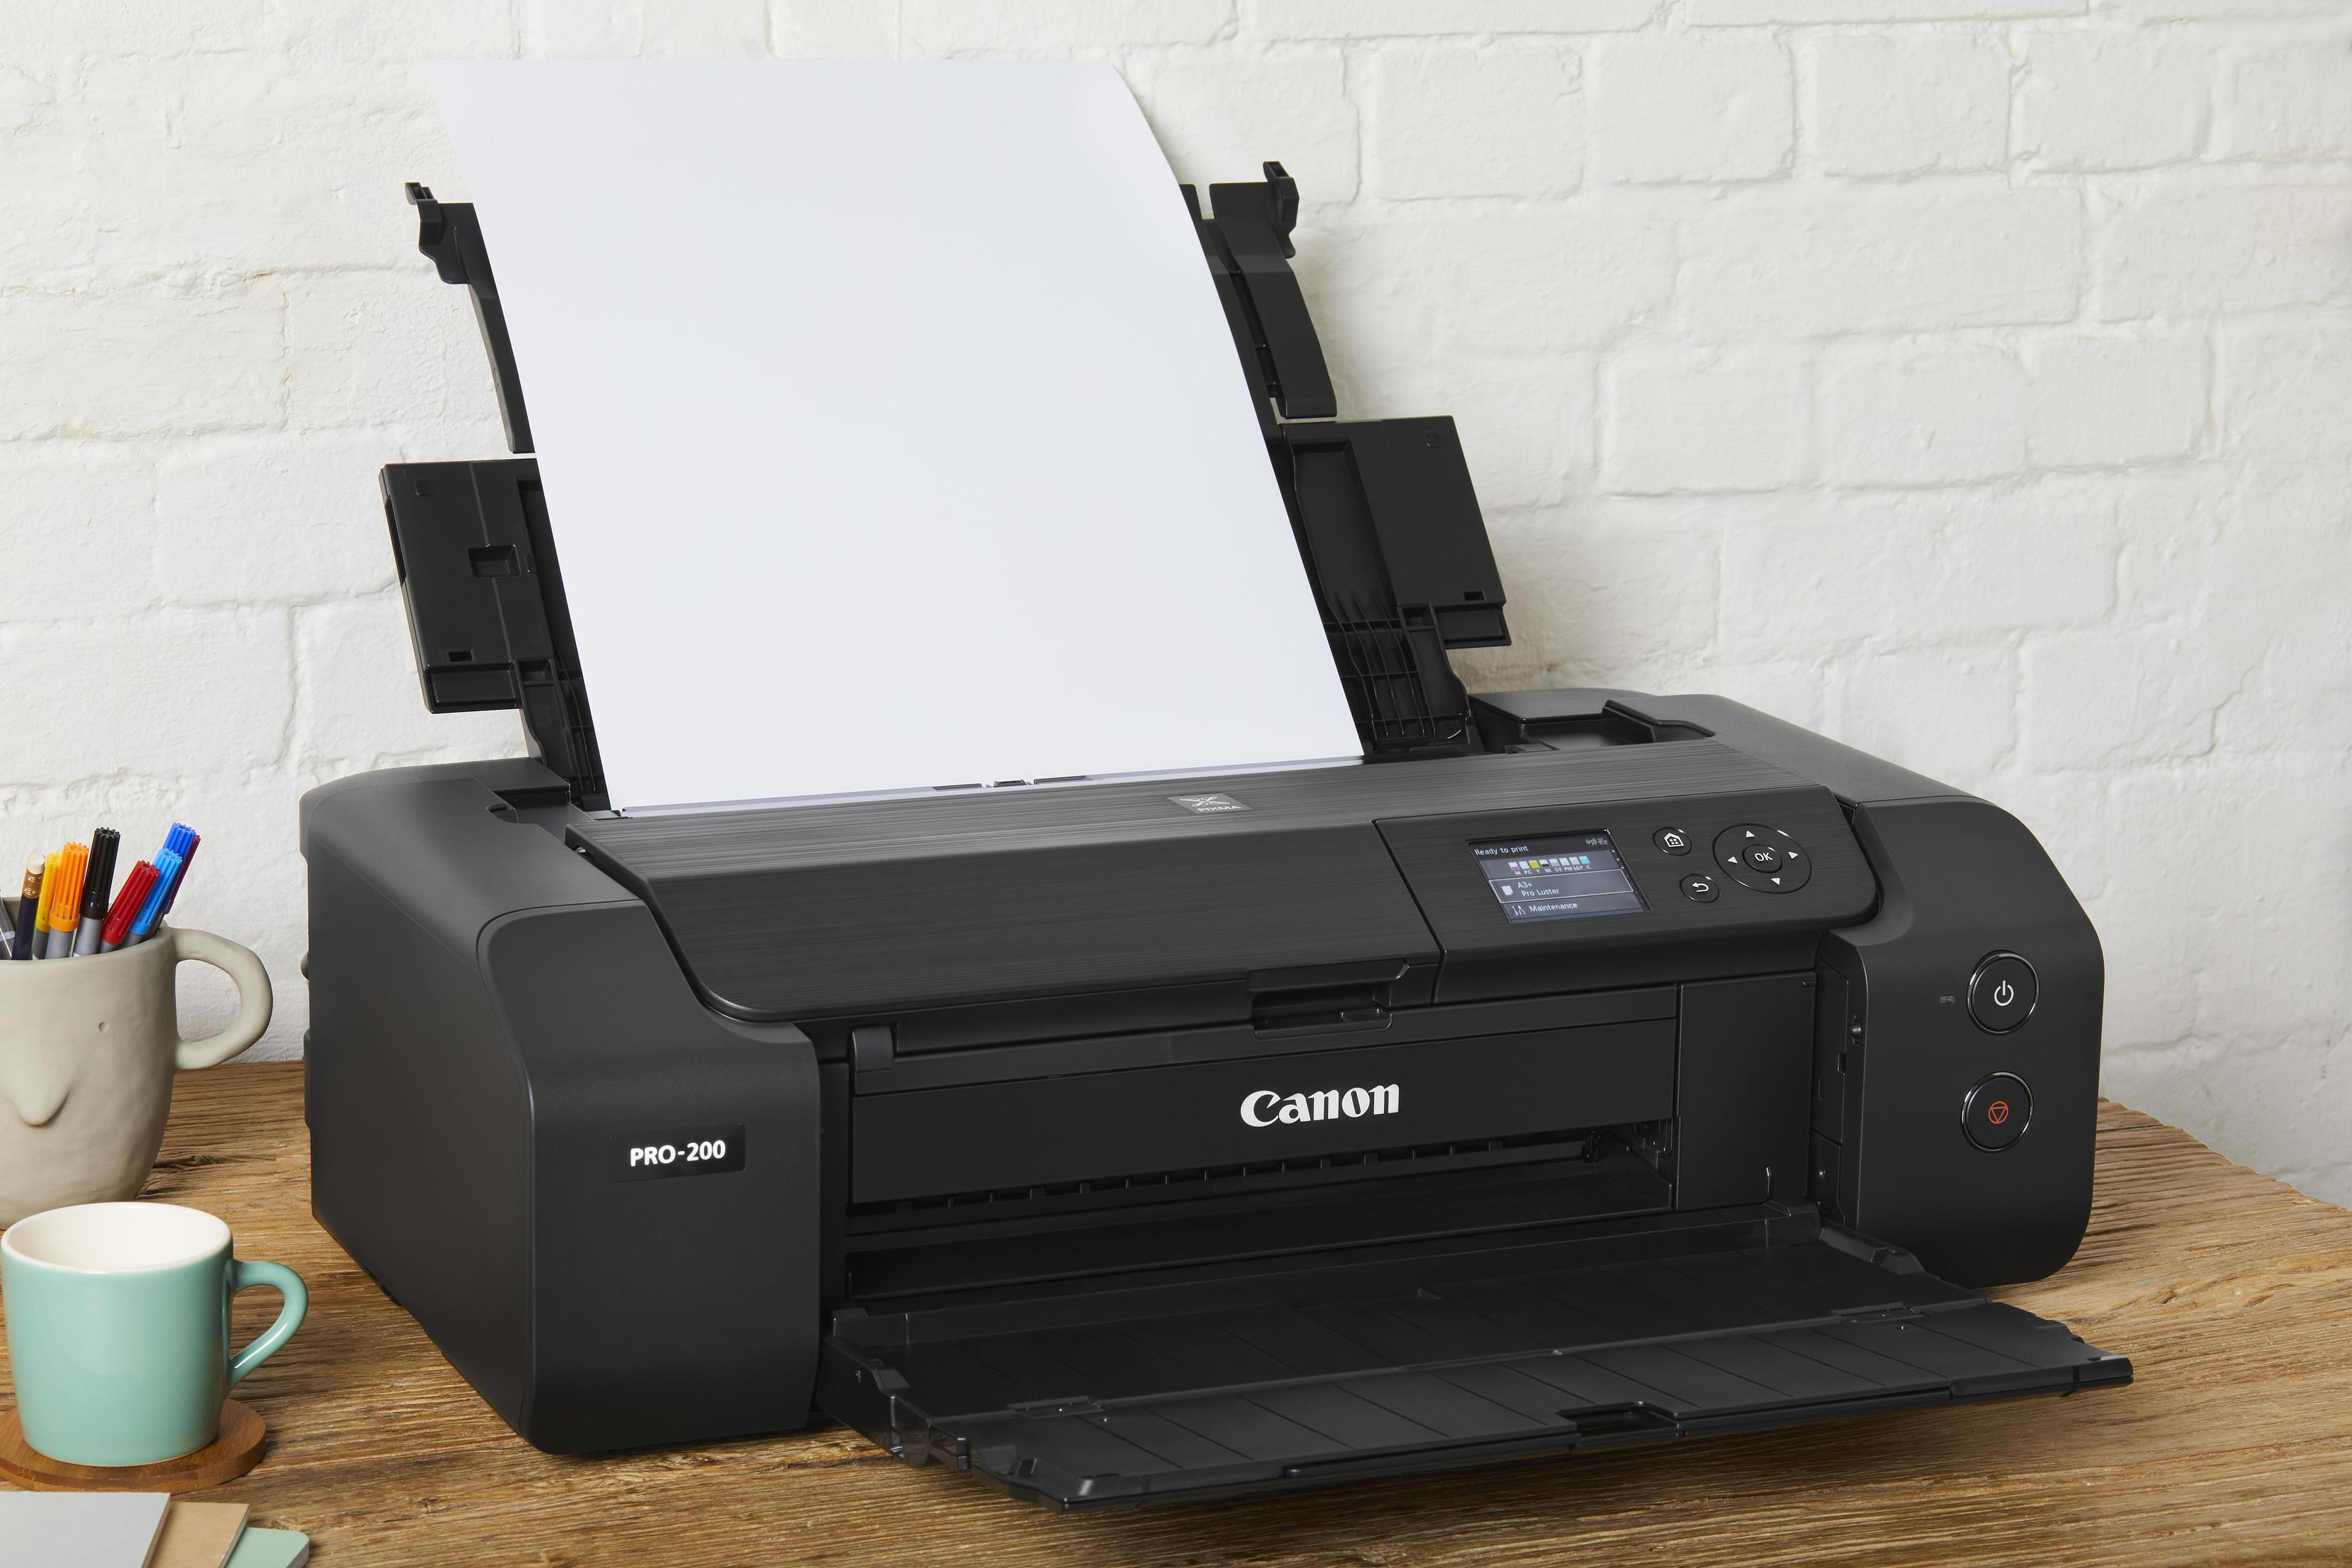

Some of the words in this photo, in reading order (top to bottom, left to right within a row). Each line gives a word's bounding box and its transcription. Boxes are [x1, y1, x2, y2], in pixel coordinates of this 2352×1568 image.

[1475, 847, 1497, 856] Ready
[1510, 845, 1529, 855] print
[1754, 852, 1773, 862] OK
[1529, 902, 1578, 912] Maintenance
[1240, 1083, 1400, 1128] Canon
[630, 1140, 726, 1167] PRO-200
